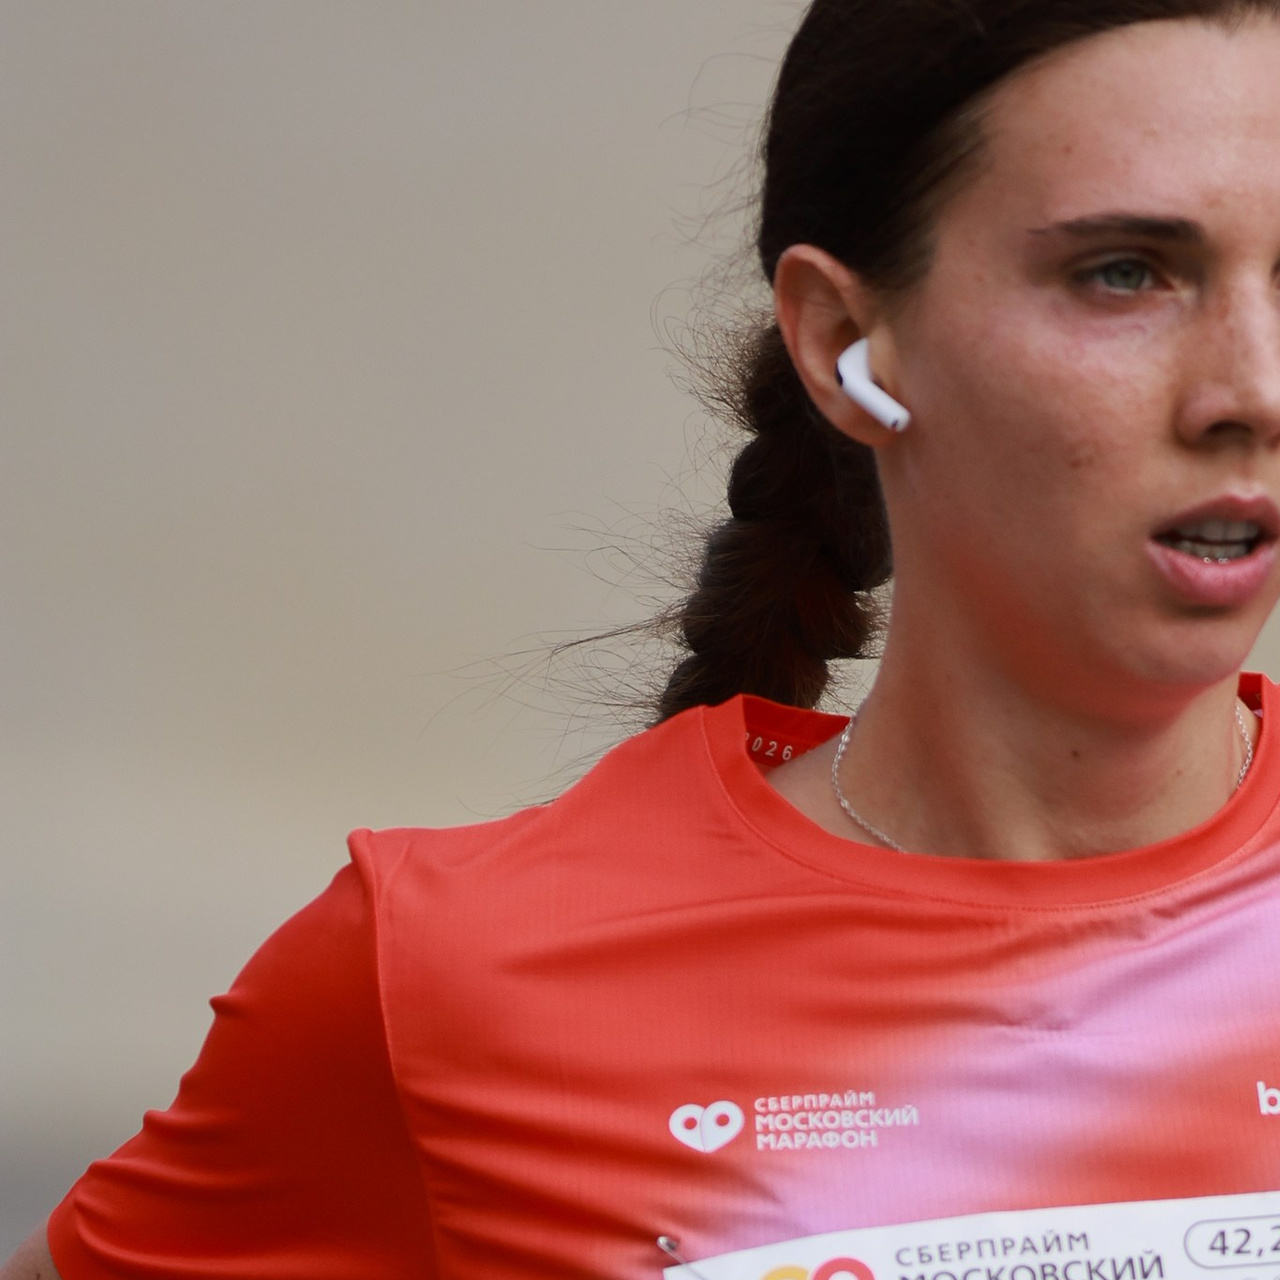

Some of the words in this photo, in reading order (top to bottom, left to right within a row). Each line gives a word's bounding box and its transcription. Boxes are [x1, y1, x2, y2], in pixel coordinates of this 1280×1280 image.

[754, 1091, 875, 1112] СБЕРПРАЙМ
[755, 1104, 919, 1131] МОСКОВСКИЙ
[757, 1128, 878, 1150] МАРАФОН
[895, 1231, 1090, 1266] СБЕРПРАЙМ
